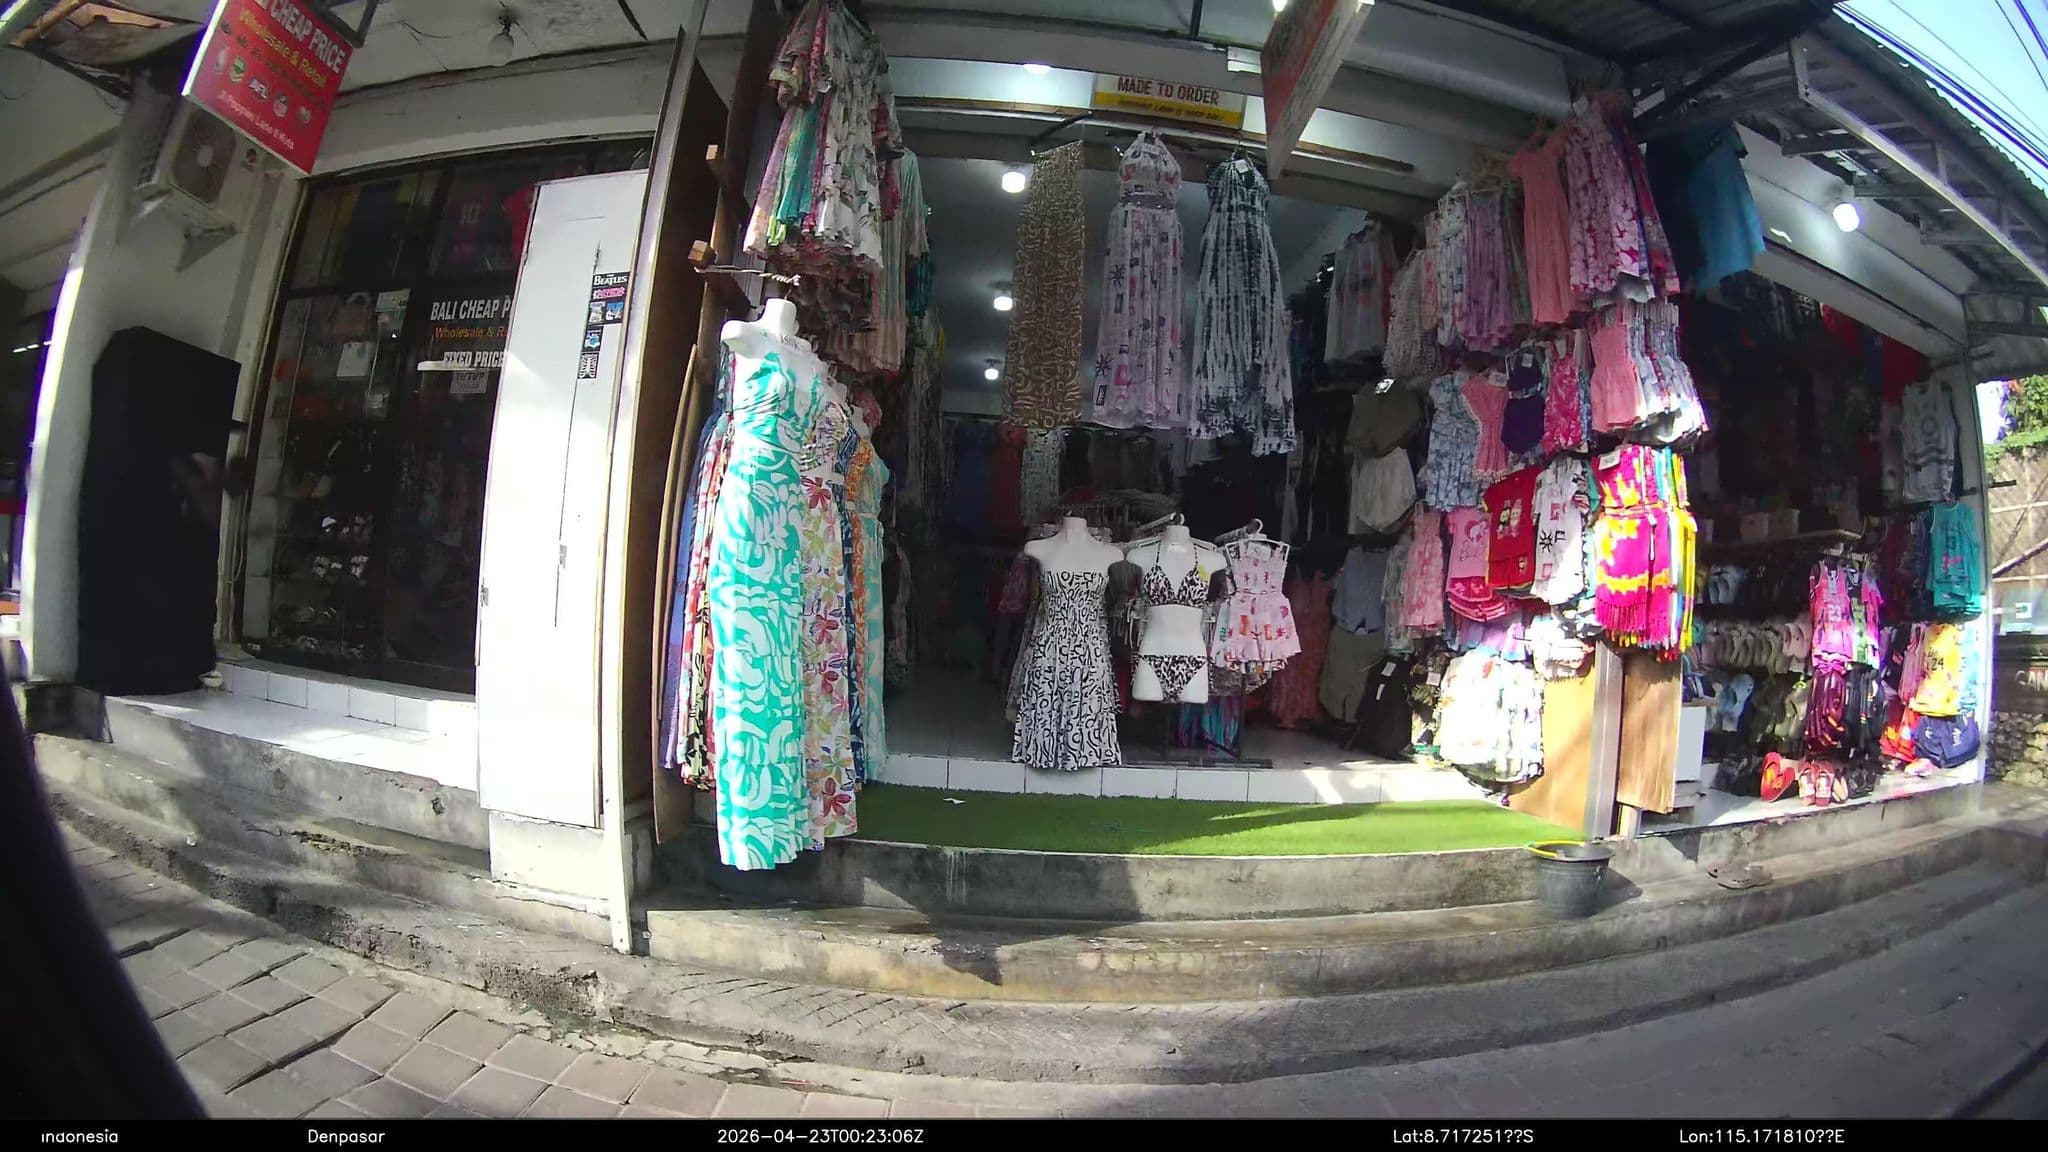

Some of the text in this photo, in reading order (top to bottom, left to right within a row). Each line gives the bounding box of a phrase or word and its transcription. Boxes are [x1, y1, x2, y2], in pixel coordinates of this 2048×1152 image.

[290, 50, 300, 67] &
[309, 28, 346, 73] PRICE
[1117, 77, 1219, 106] MADE TO ORDER
[594, 275, 628, 286] BEATLES
[430, 301, 458, 321] BALI
[459, 299, 500, 319] CHEAP
[486, 327, 495, 337] &
[442, 351, 472, 368] FIXED
